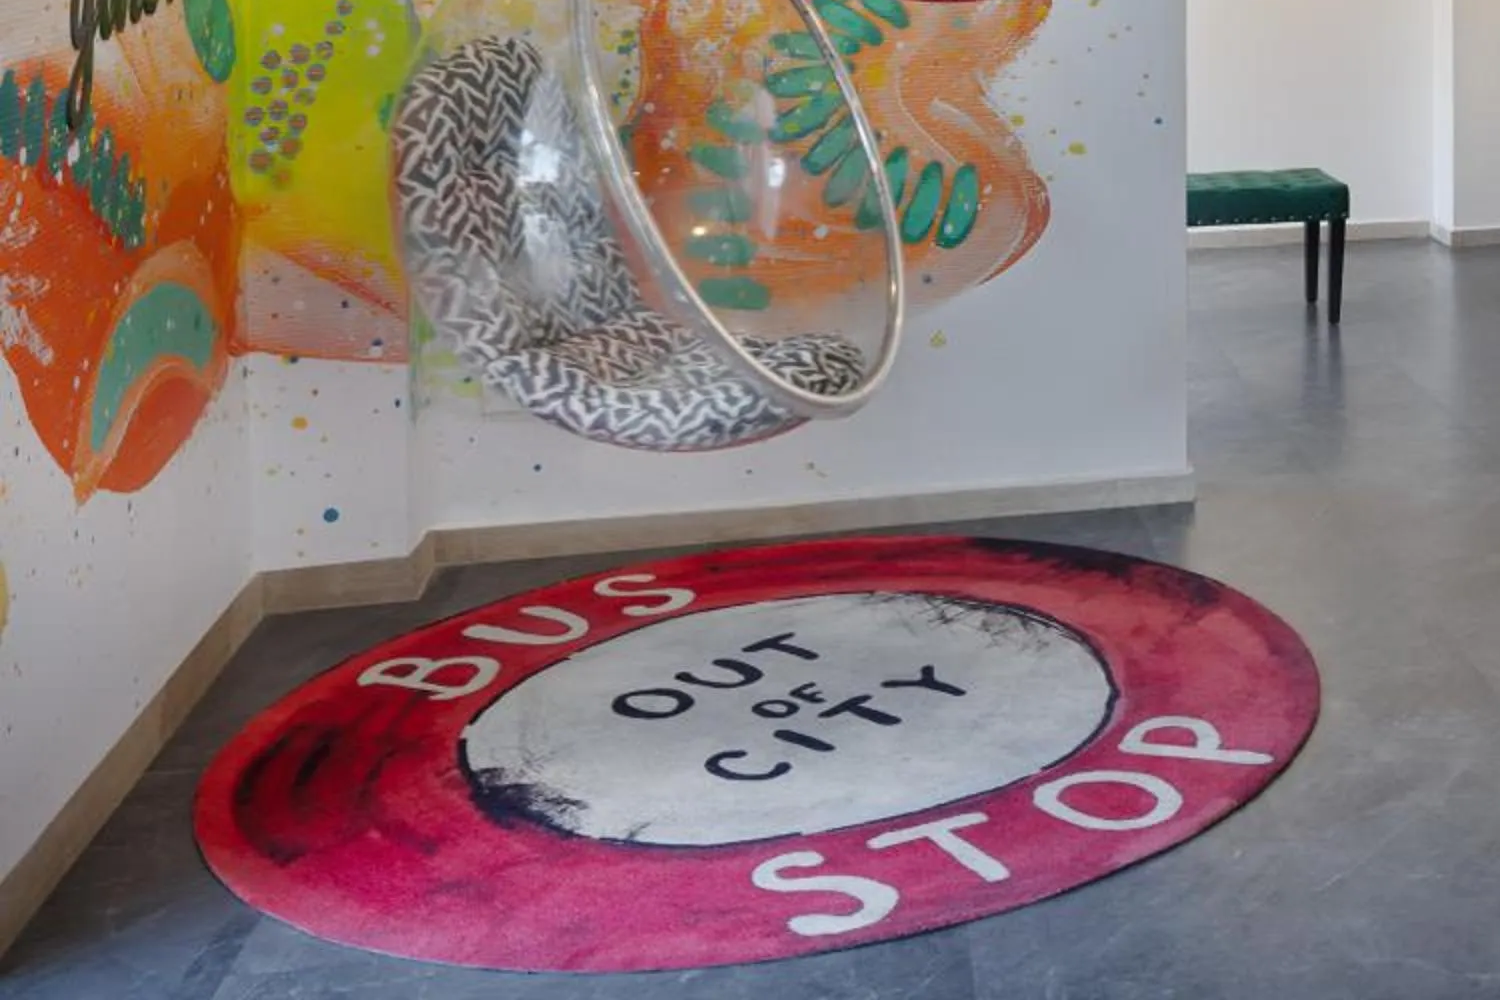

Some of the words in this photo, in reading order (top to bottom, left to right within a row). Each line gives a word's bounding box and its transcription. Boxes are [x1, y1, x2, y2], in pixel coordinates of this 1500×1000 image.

[356, 572, 698, 702] BUS
[611, 632, 821, 723] OUT
[703, 664, 969, 783] CITY
[752, 683, 828, 719] OF
[750, 713, 1276, 939] STOP
